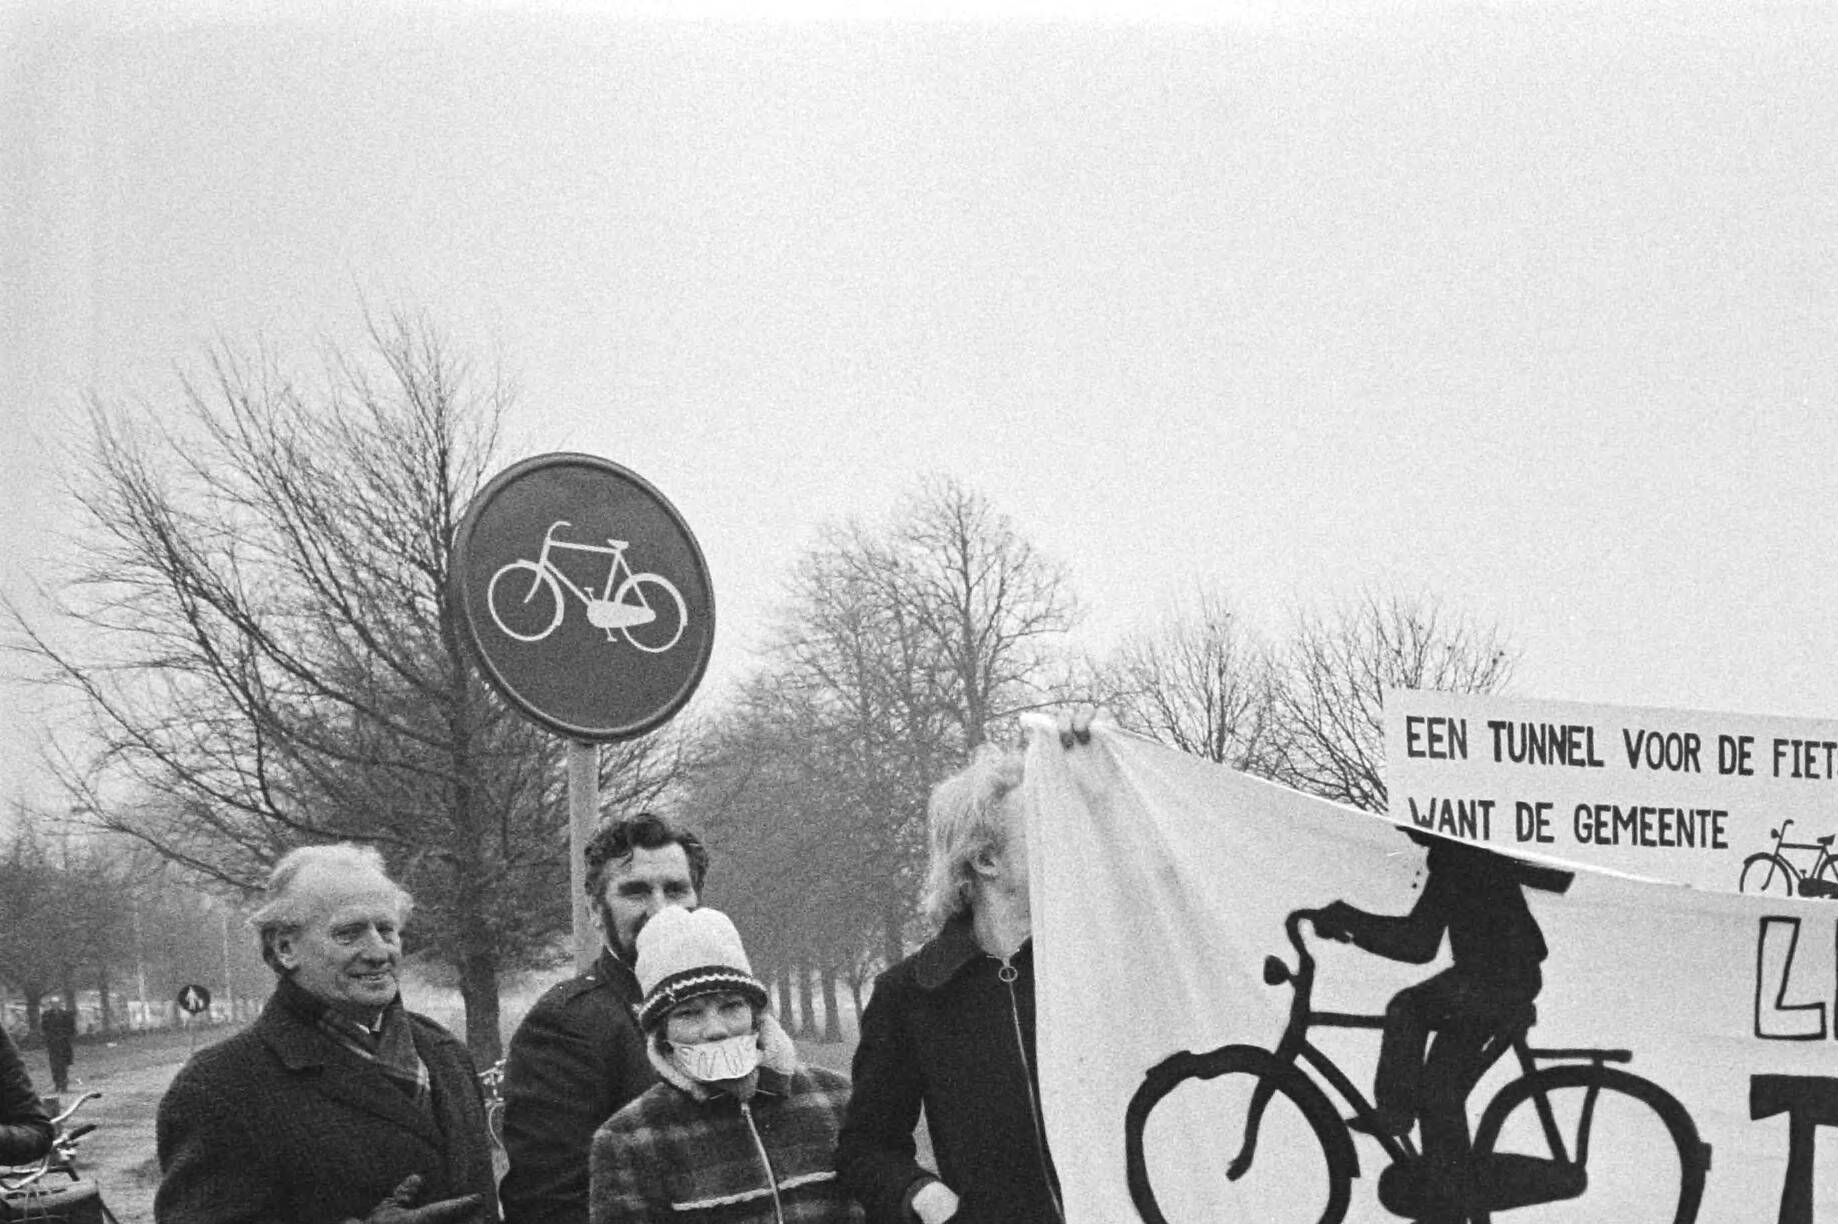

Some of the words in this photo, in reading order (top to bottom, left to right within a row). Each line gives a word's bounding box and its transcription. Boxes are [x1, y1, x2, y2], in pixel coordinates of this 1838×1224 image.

[1406, 716, 1467, 760] EEN
[1488, 720, 1604, 767] TUNNEL
[1623, 729, 1701, 773] VOOR
[1718, 735, 1755, 776] DE
[1408, 797, 1495, 840] WANT
[1516, 801, 1554, 843] DE
[1574, 804, 1728, 849] GEMEENTE
